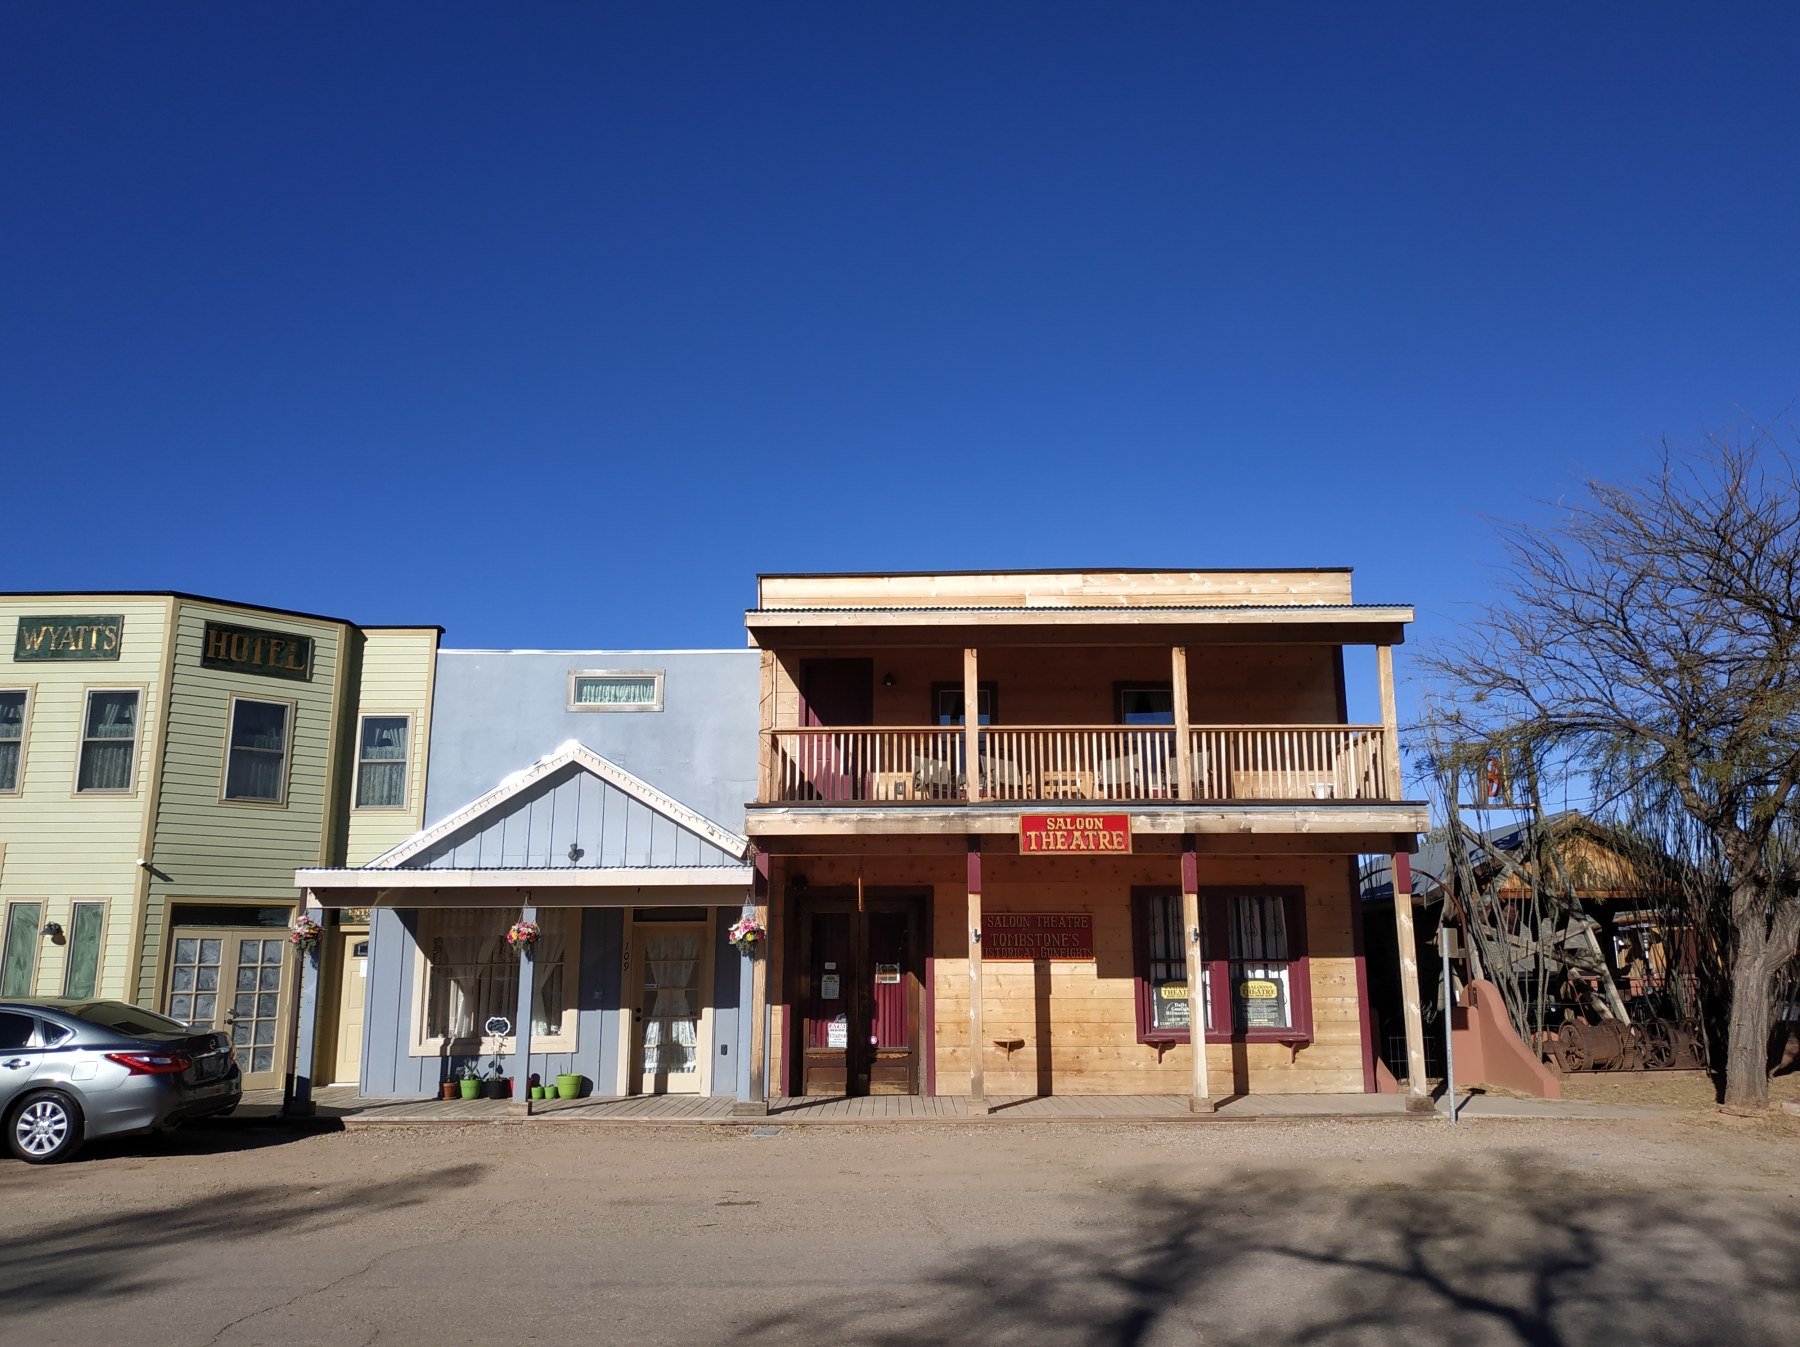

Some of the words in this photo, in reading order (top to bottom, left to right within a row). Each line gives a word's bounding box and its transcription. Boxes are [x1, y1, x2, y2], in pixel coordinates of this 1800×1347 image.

[22, 624, 117, 651] WYATT'S
[206, 629, 305, 671] HOTEL
[1046, 817, 1104, 830] SALOON
[1026, 830, 1126, 850] THEATRE
[987, 916, 1031, 928] SALOON
[1036, 916, 1089, 928] THEATRE
[991, 933, 1080, 947] TOMBSTONE'S
[982, 948, 1039, 959] ISTORICAL
